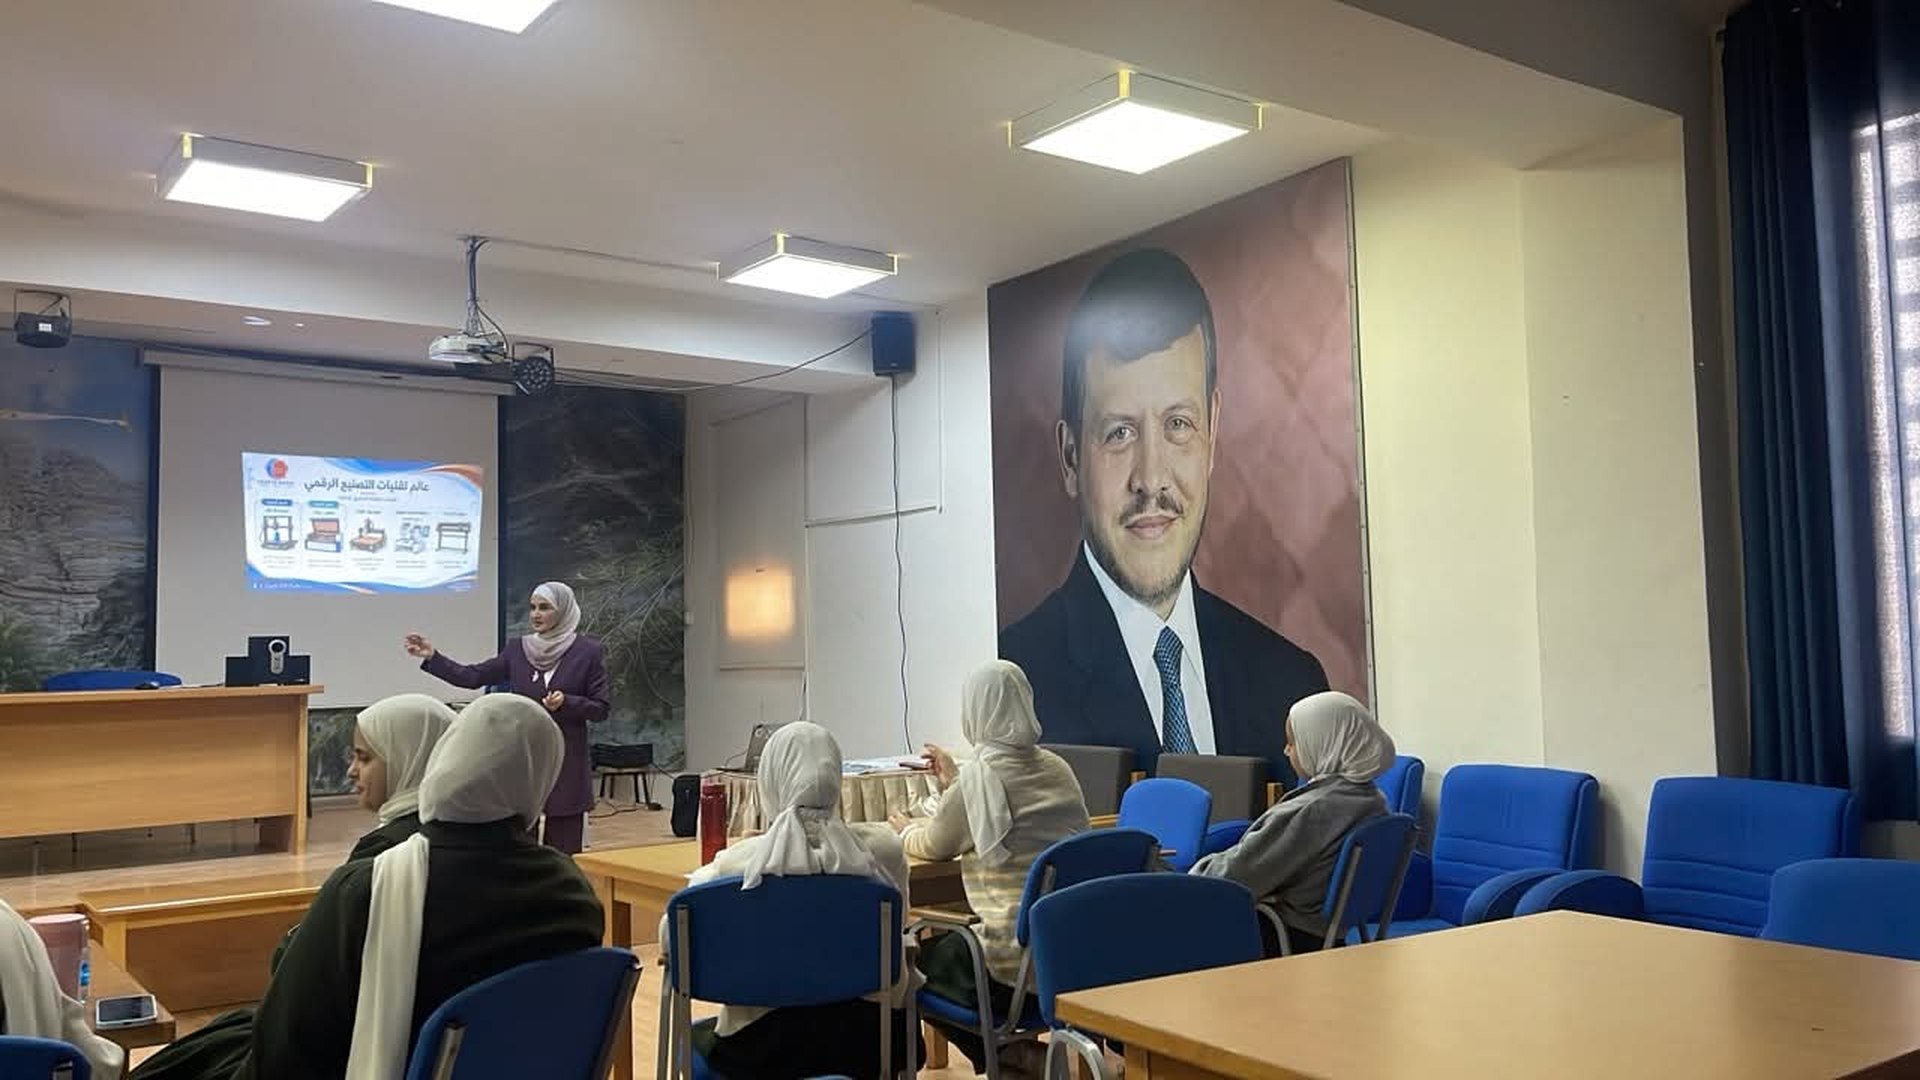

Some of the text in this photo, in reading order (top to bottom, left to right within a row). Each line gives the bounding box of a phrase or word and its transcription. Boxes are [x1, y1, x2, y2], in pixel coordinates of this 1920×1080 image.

[304, 477, 339, 492] الرقمي
[340, 479, 375, 492] التصنيع
[376, 479, 408, 492] تقنيات
[410, 480, 430, 491] عالم
